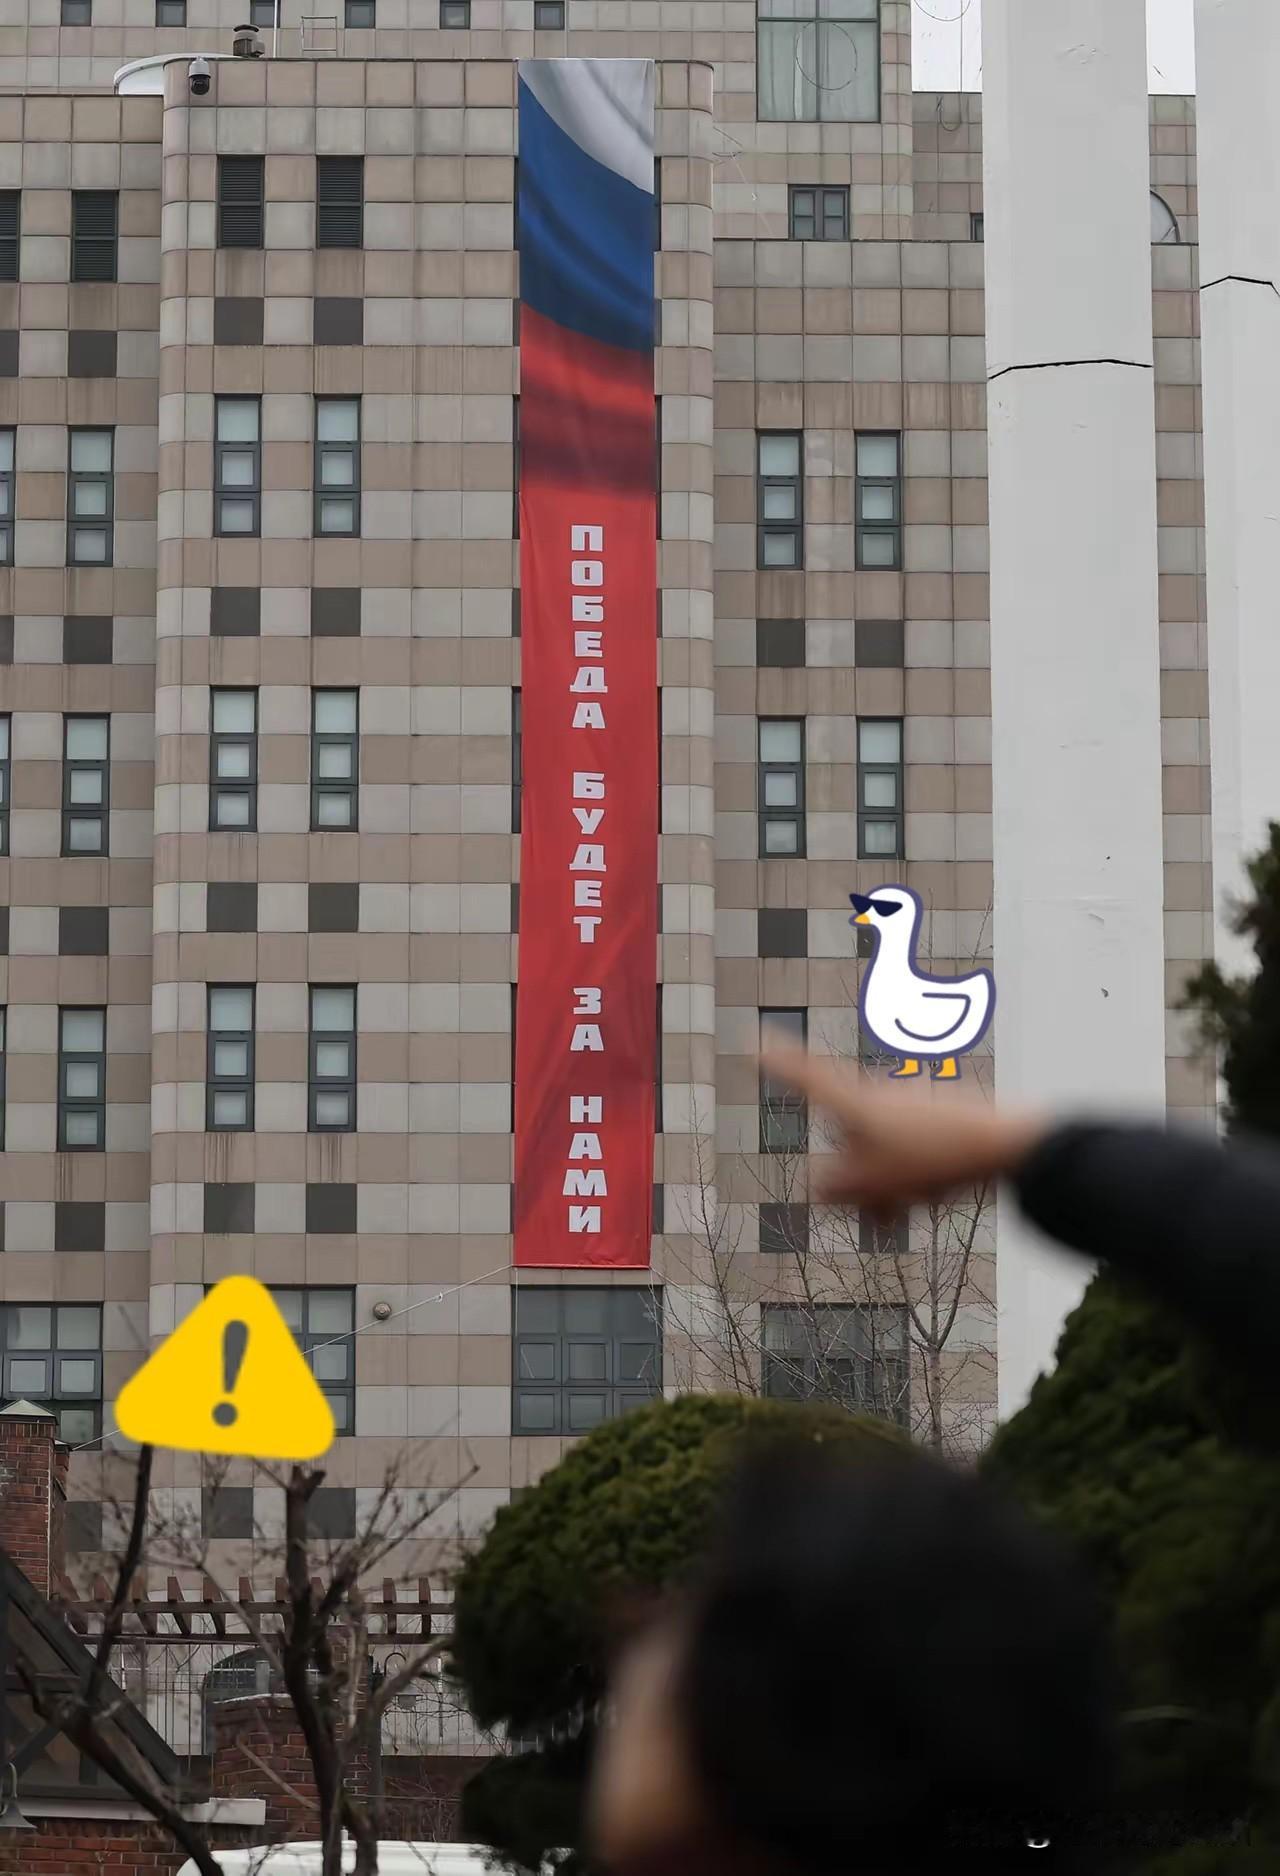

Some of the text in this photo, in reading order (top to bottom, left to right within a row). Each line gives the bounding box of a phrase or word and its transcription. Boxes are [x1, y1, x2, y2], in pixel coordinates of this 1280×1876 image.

[562, 524, 608, 1233] ПОБЕДА БУДЕТ ЗА НАМИ
